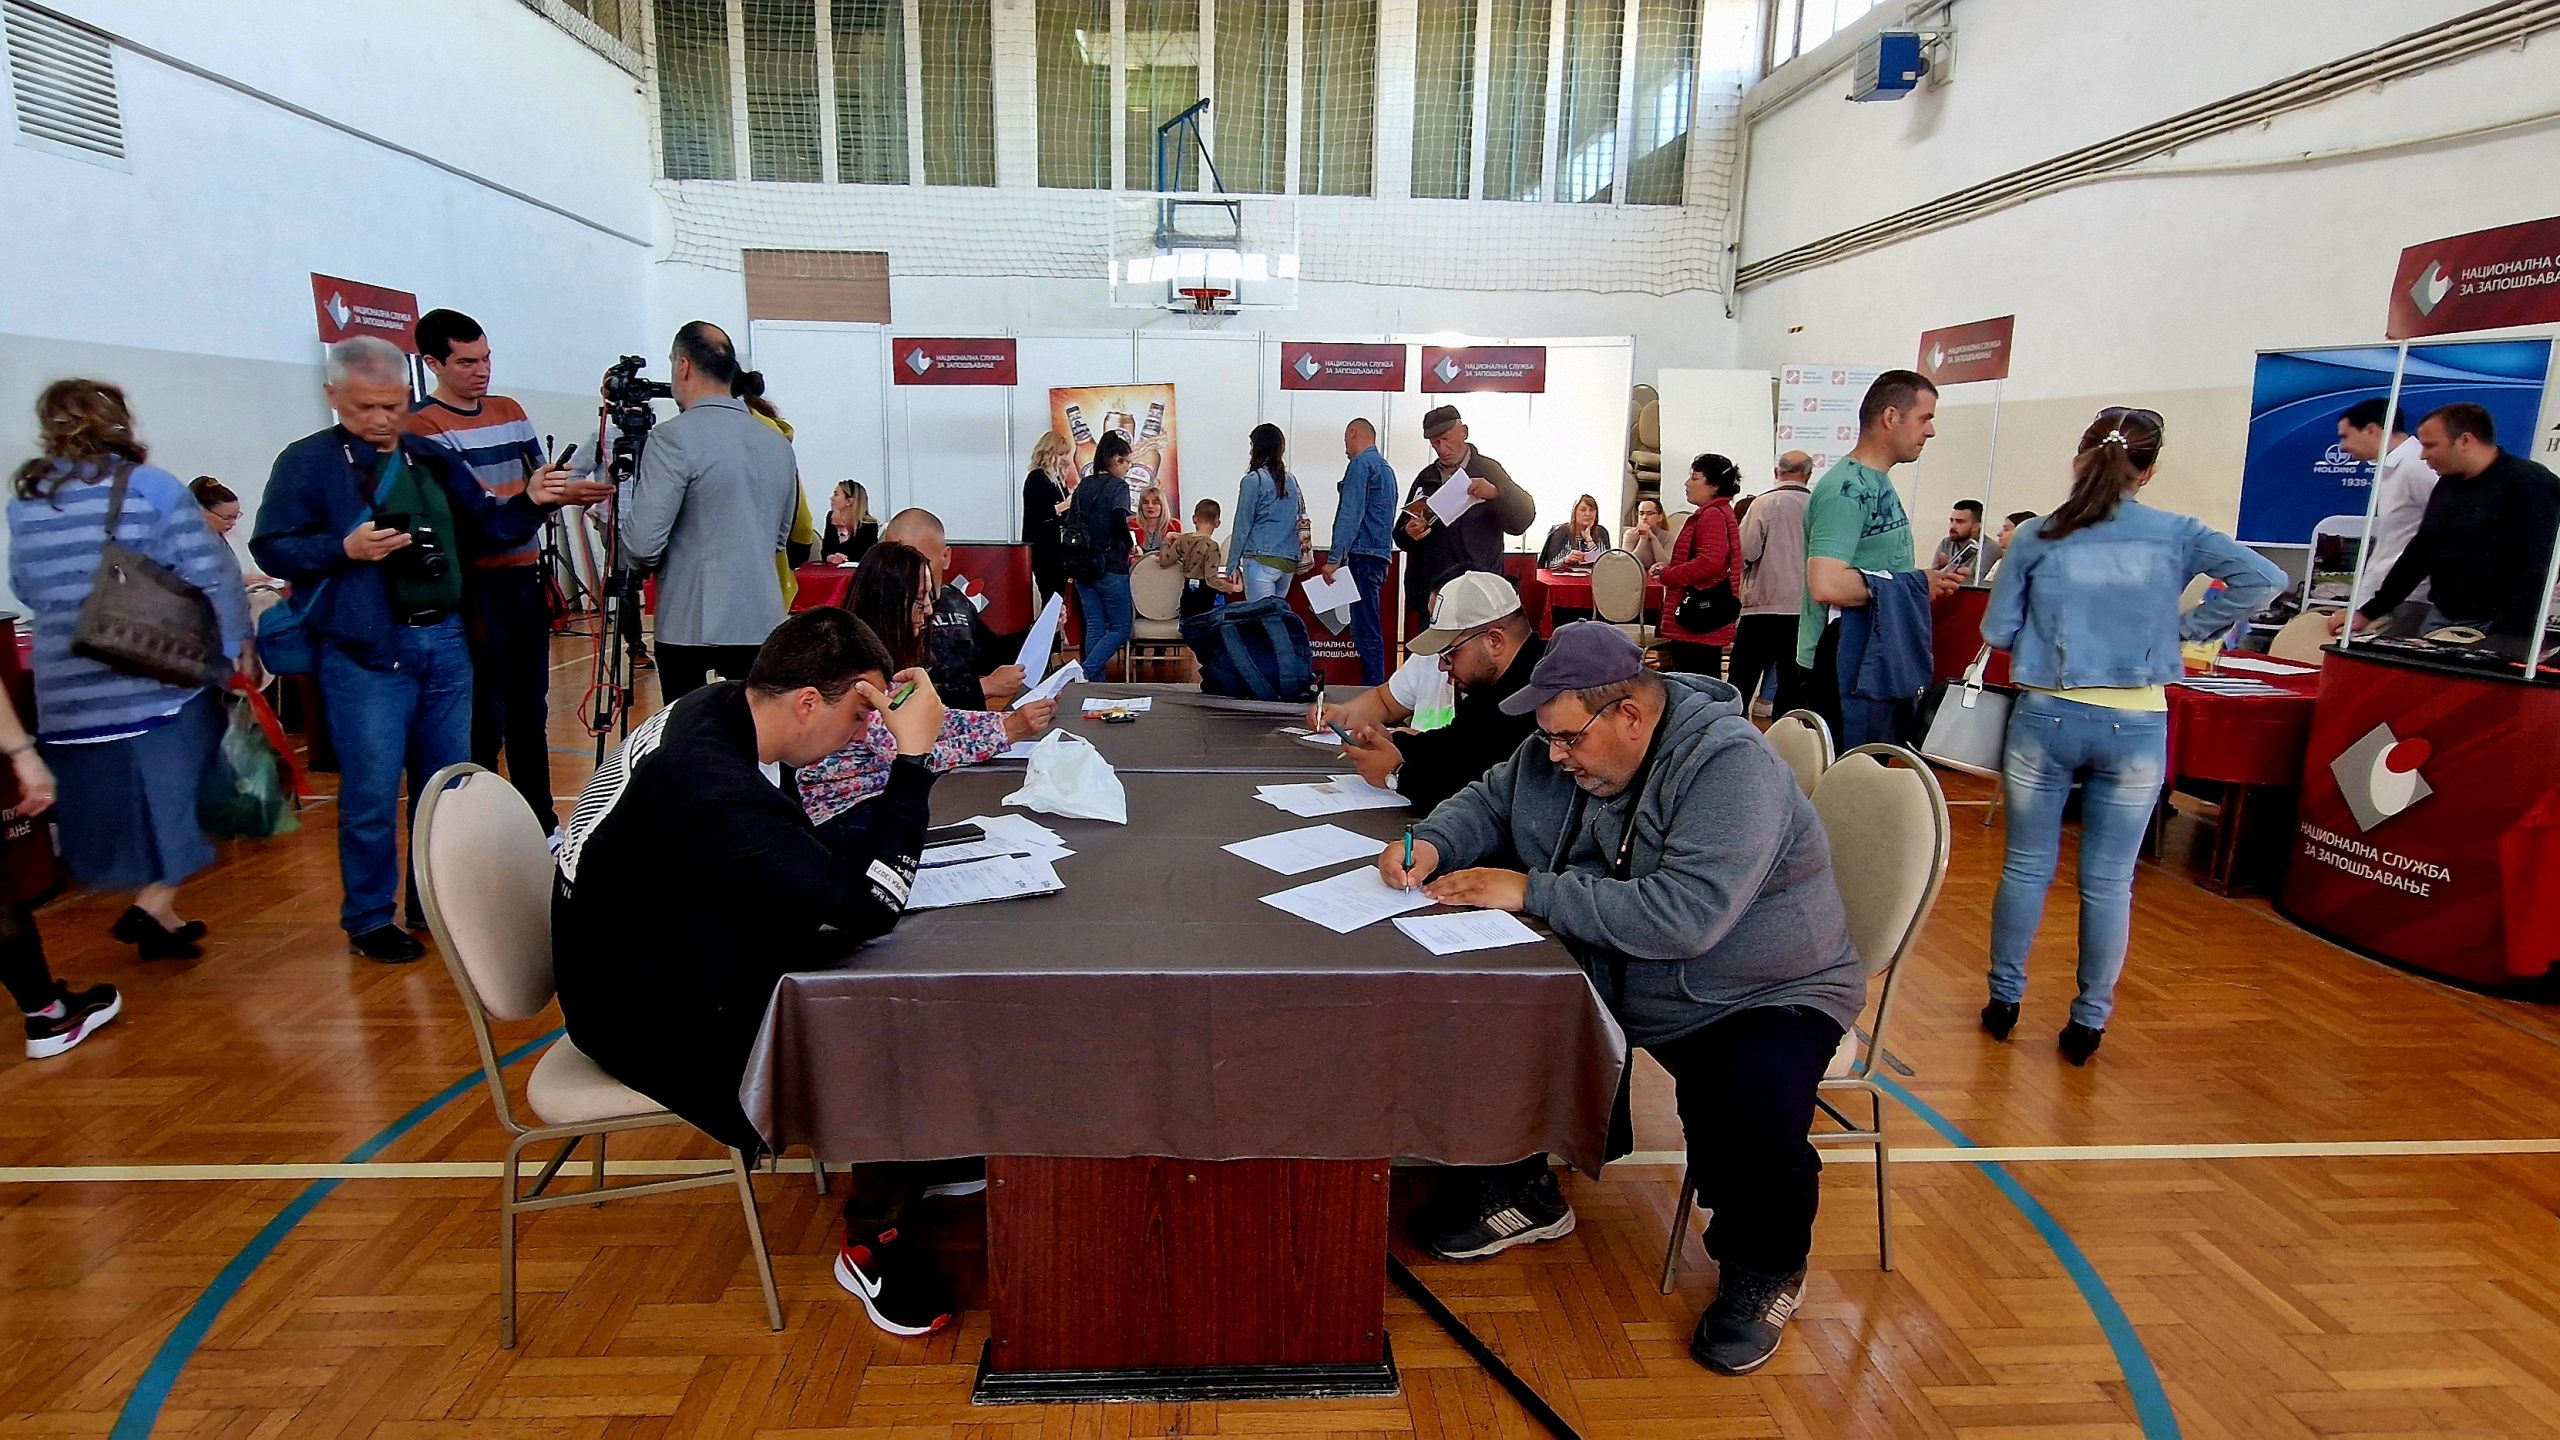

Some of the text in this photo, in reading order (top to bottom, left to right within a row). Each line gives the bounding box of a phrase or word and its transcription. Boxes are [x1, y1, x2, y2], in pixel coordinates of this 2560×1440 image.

[2461, 256, 2552, 281] НАЦИОНАЛНА
[2459, 271, 2560, 296] ЗА ЗАПОШЉАВА
[1325, 360, 1368, 368] НАЦИОНАЛНА
[2313, 466, 2357, 474] HOLDING
[2341, 477, 2372, 487] 1939-
[1309, 640, 1346, 649] ИОНАЛНА
[1311, 650, 1360, 658] ЗАПОШЉАВА
[2300, 821, 2451, 883] НАЦИОНАЛНА СЛУЖБА
[2304, 842, 2431, 898] ЗА ЗАПОШЉАВАЊЕ
